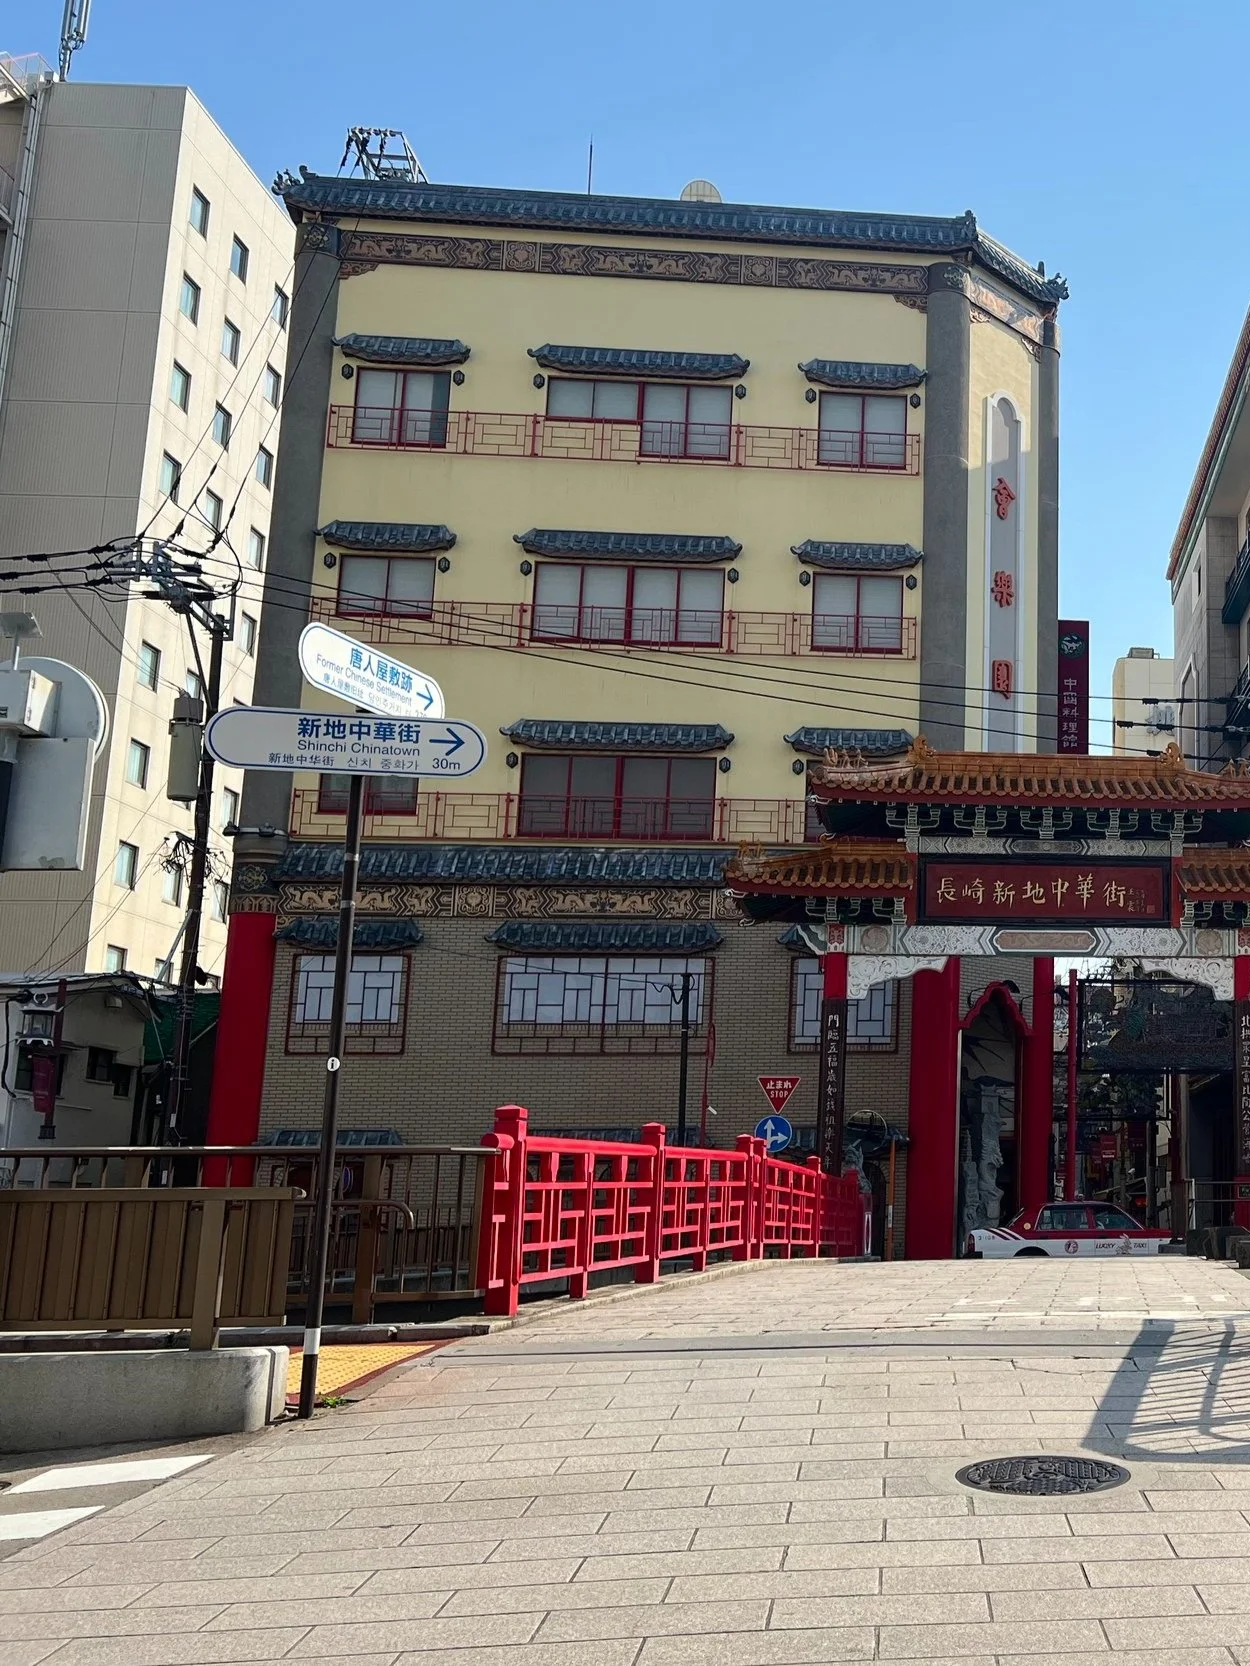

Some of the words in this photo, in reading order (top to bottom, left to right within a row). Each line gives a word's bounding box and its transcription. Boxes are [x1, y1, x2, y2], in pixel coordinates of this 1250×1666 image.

[349, 646, 414, 694] 唐人屋敷跡
[316, 653, 344, 675] Former
[345, 666, 375, 690] Chinese
[376, 680, 413, 707] Settlement
[297, 717, 421, 745] 新地中華街
[296, 739, 347, 753] Shinchi
[350, 742, 421, 757] Chinatown
[267, 752, 335, 768] 新地中华街
[346, 756, 373, 770] 신치
[380, 756, 420, 771] 중화가
[431, 756, 462, 771] 30m
[936, 872, 1126, 911] 長崎新地中華街
[765, 1079, 793, 1090] 止まれ
[770, 1090, 789, 1099] STOP
